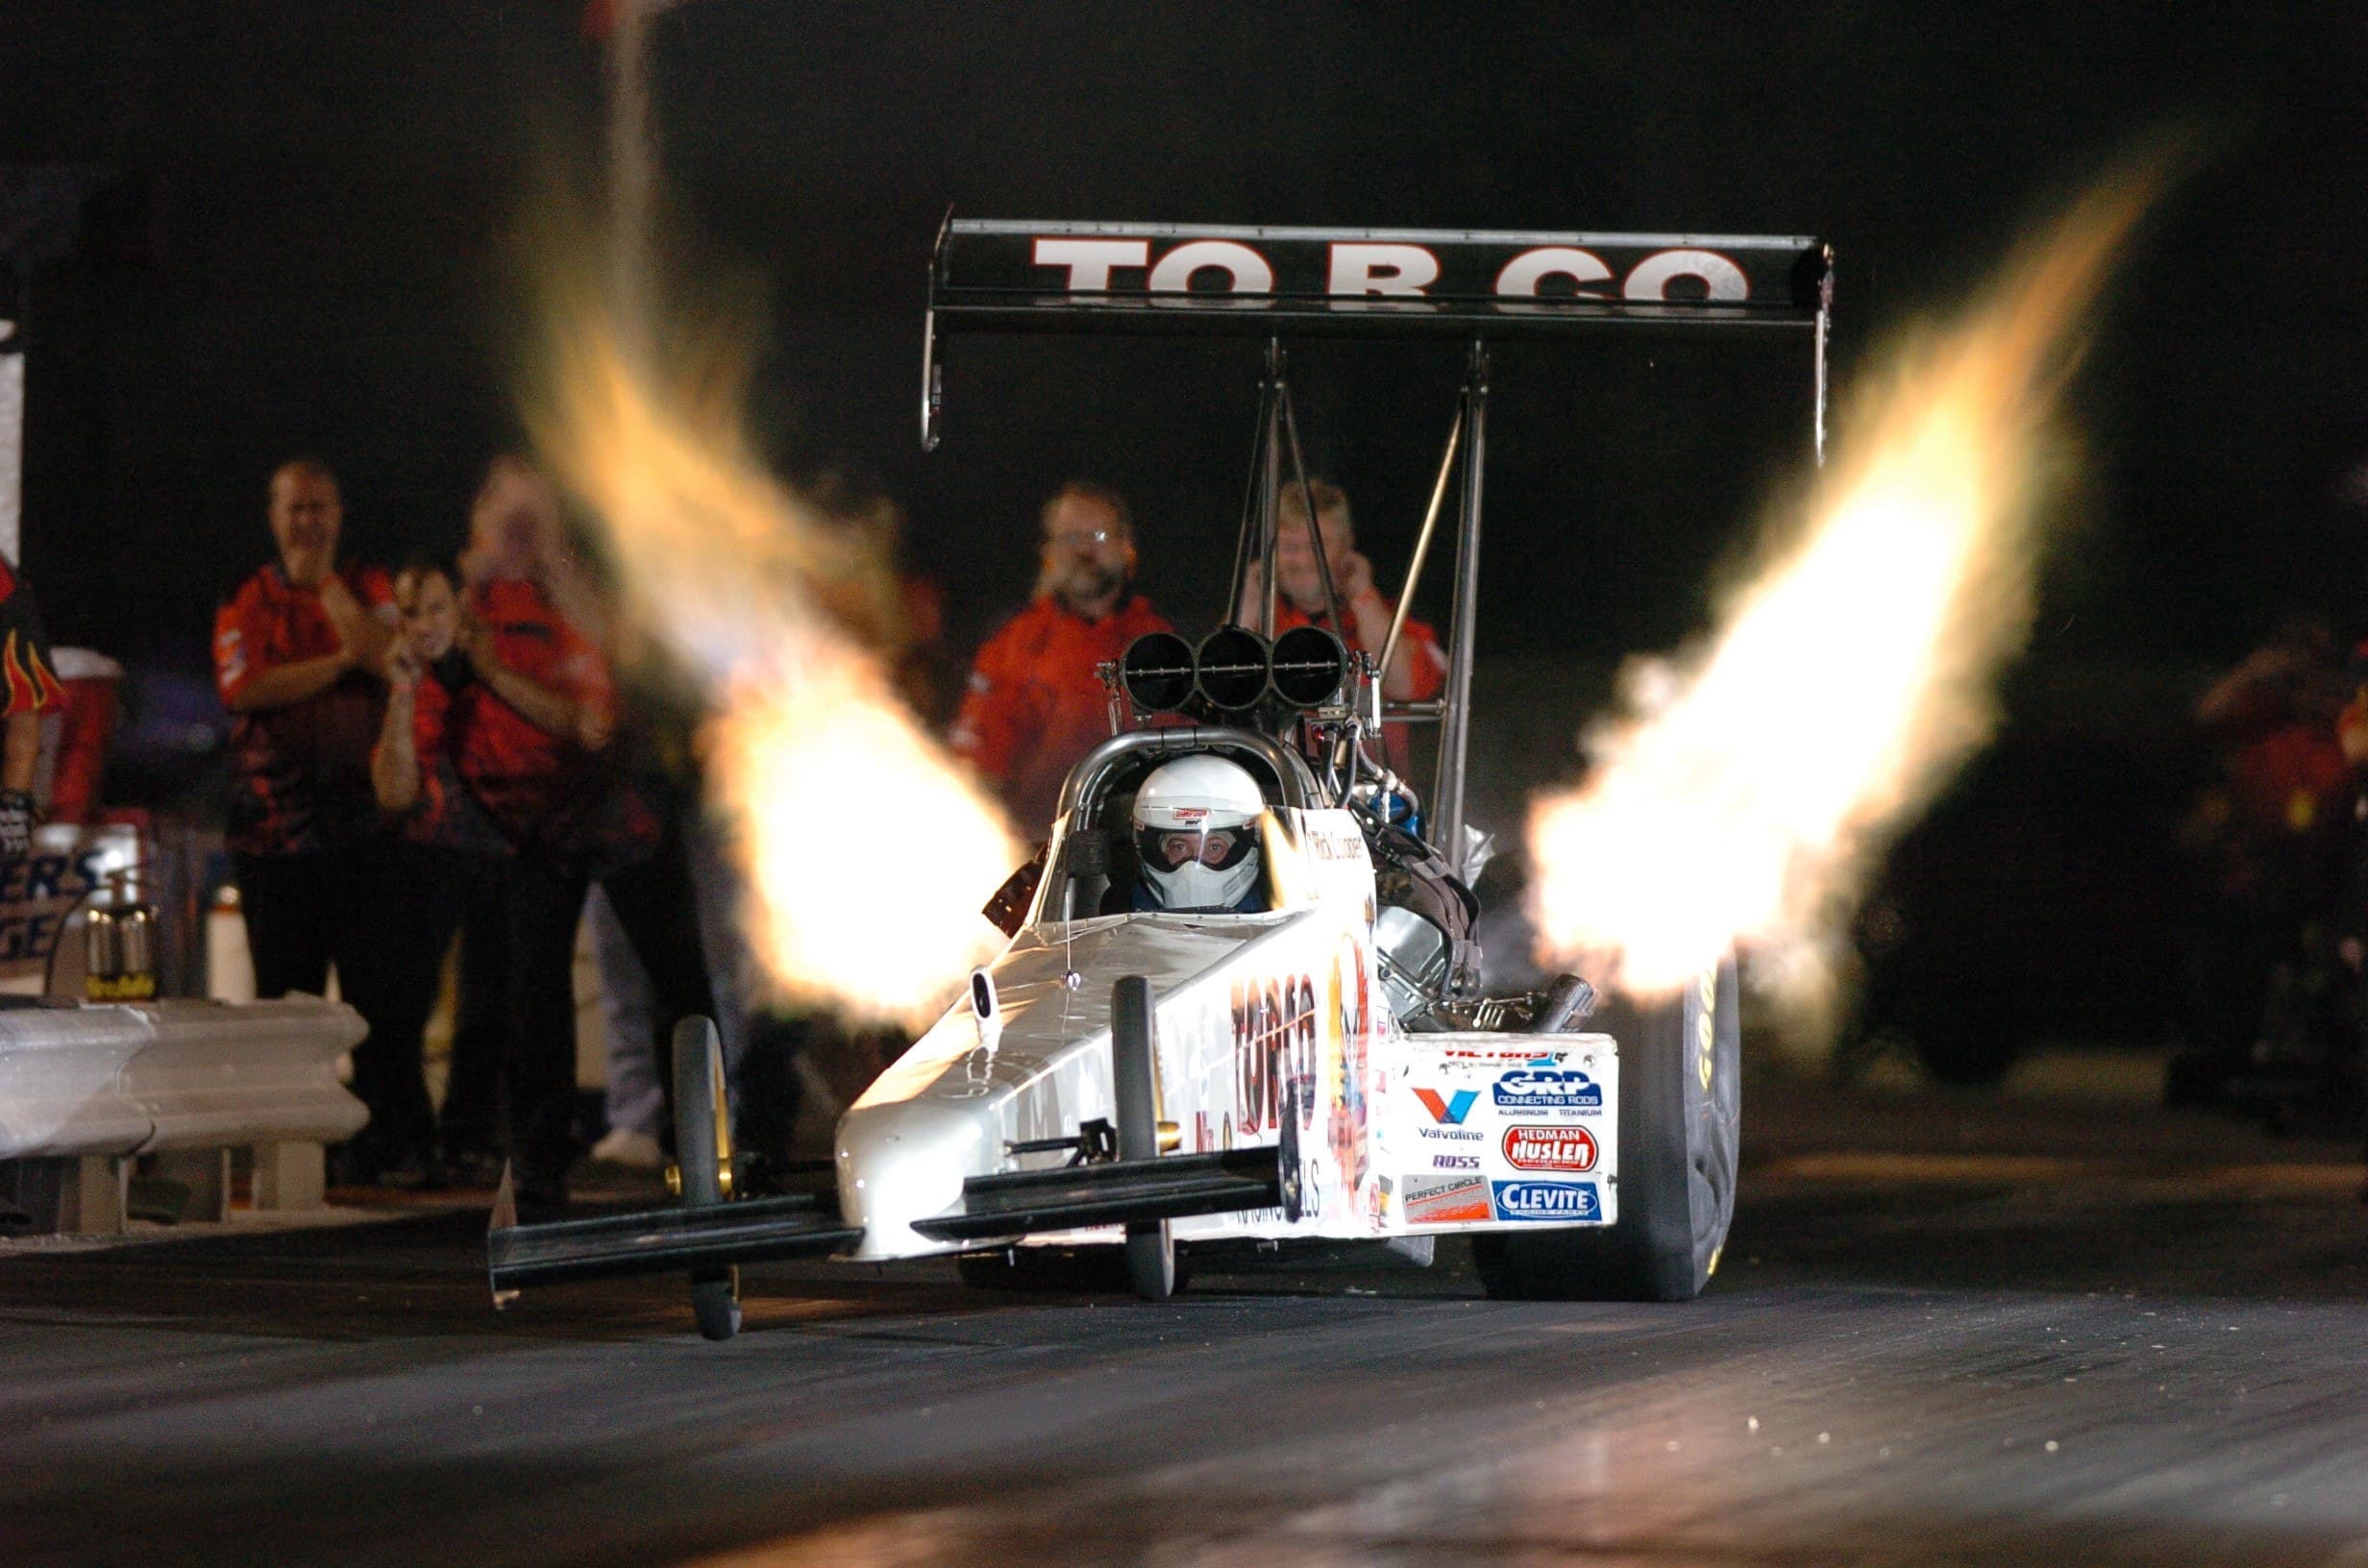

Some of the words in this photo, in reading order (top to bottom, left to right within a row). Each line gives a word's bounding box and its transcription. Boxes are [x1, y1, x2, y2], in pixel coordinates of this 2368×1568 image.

[1500, 1070, 1591, 1095] GRP
[1497, 1094, 1565, 1105] CONNECTING
[1567, 1095, 1598, 1105] RODS
[1418, 1127, 1485, 1141] Valvoline
[1517, 1129, 1581, 1140] HEDMAN
[1432, 1154, 1481, 1168] ROSS
[1511, 1140, 1590, 1166] HUSLER
[1404, 1186, 1446, 1202] PERFECT
[1447, 1175, 1484, 1191] CIRCLE
[1501, 1184, 1590, 1209] CLEVITE
